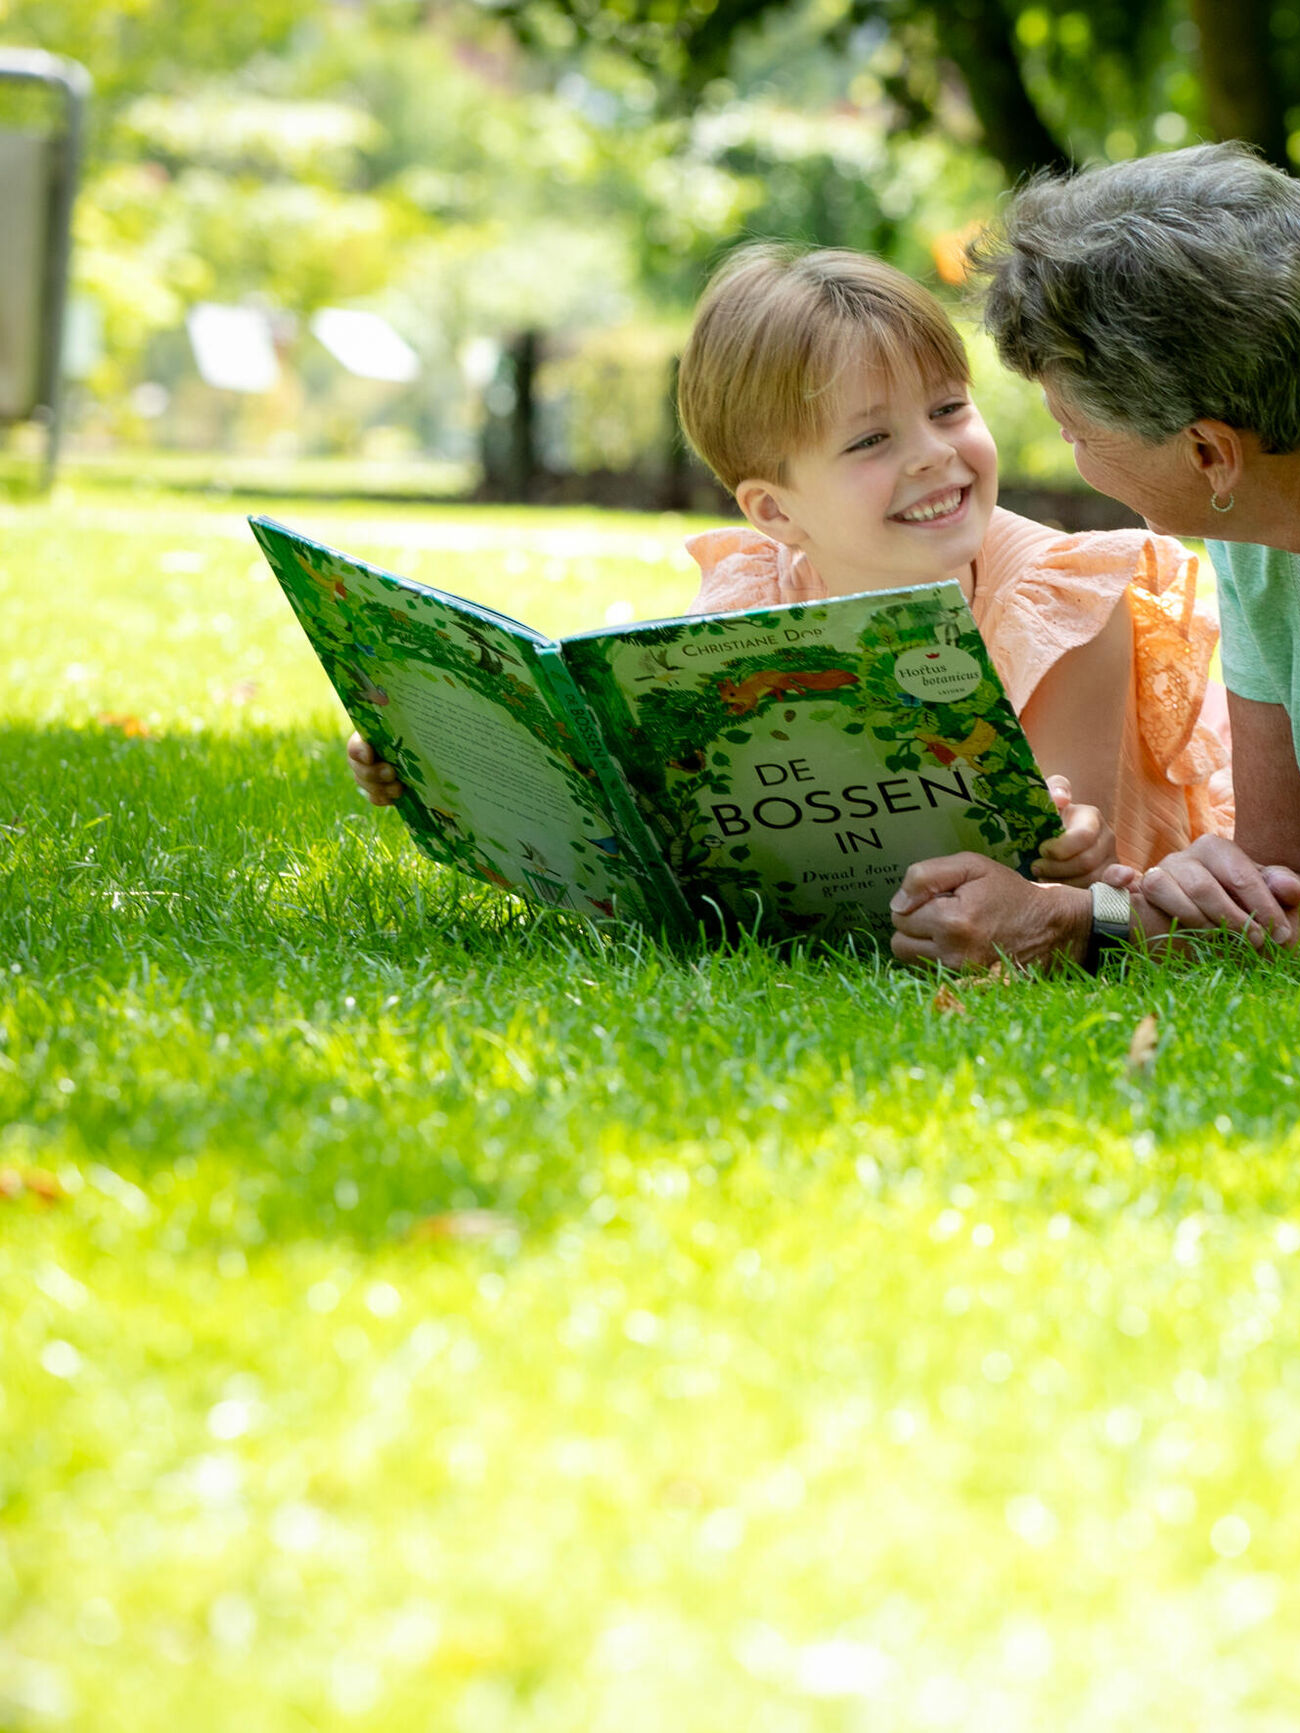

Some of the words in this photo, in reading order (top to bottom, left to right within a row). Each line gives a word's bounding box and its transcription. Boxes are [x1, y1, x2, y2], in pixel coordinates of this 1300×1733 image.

[682, 635, 779, 657] CHRISTIANE
[898, 663, 948, 678] Hortus
[921, 671, 980, 686] botanicus
[570, 708, 608, 757] BOSSEN
[754, 758, 815, 786] DE
[711, 771, 973, 836] BOSSEN
[835, 828, 883, 853] IN
[802, 866, 856, 883] Dwaal
[865, 864, 899, 875] door
